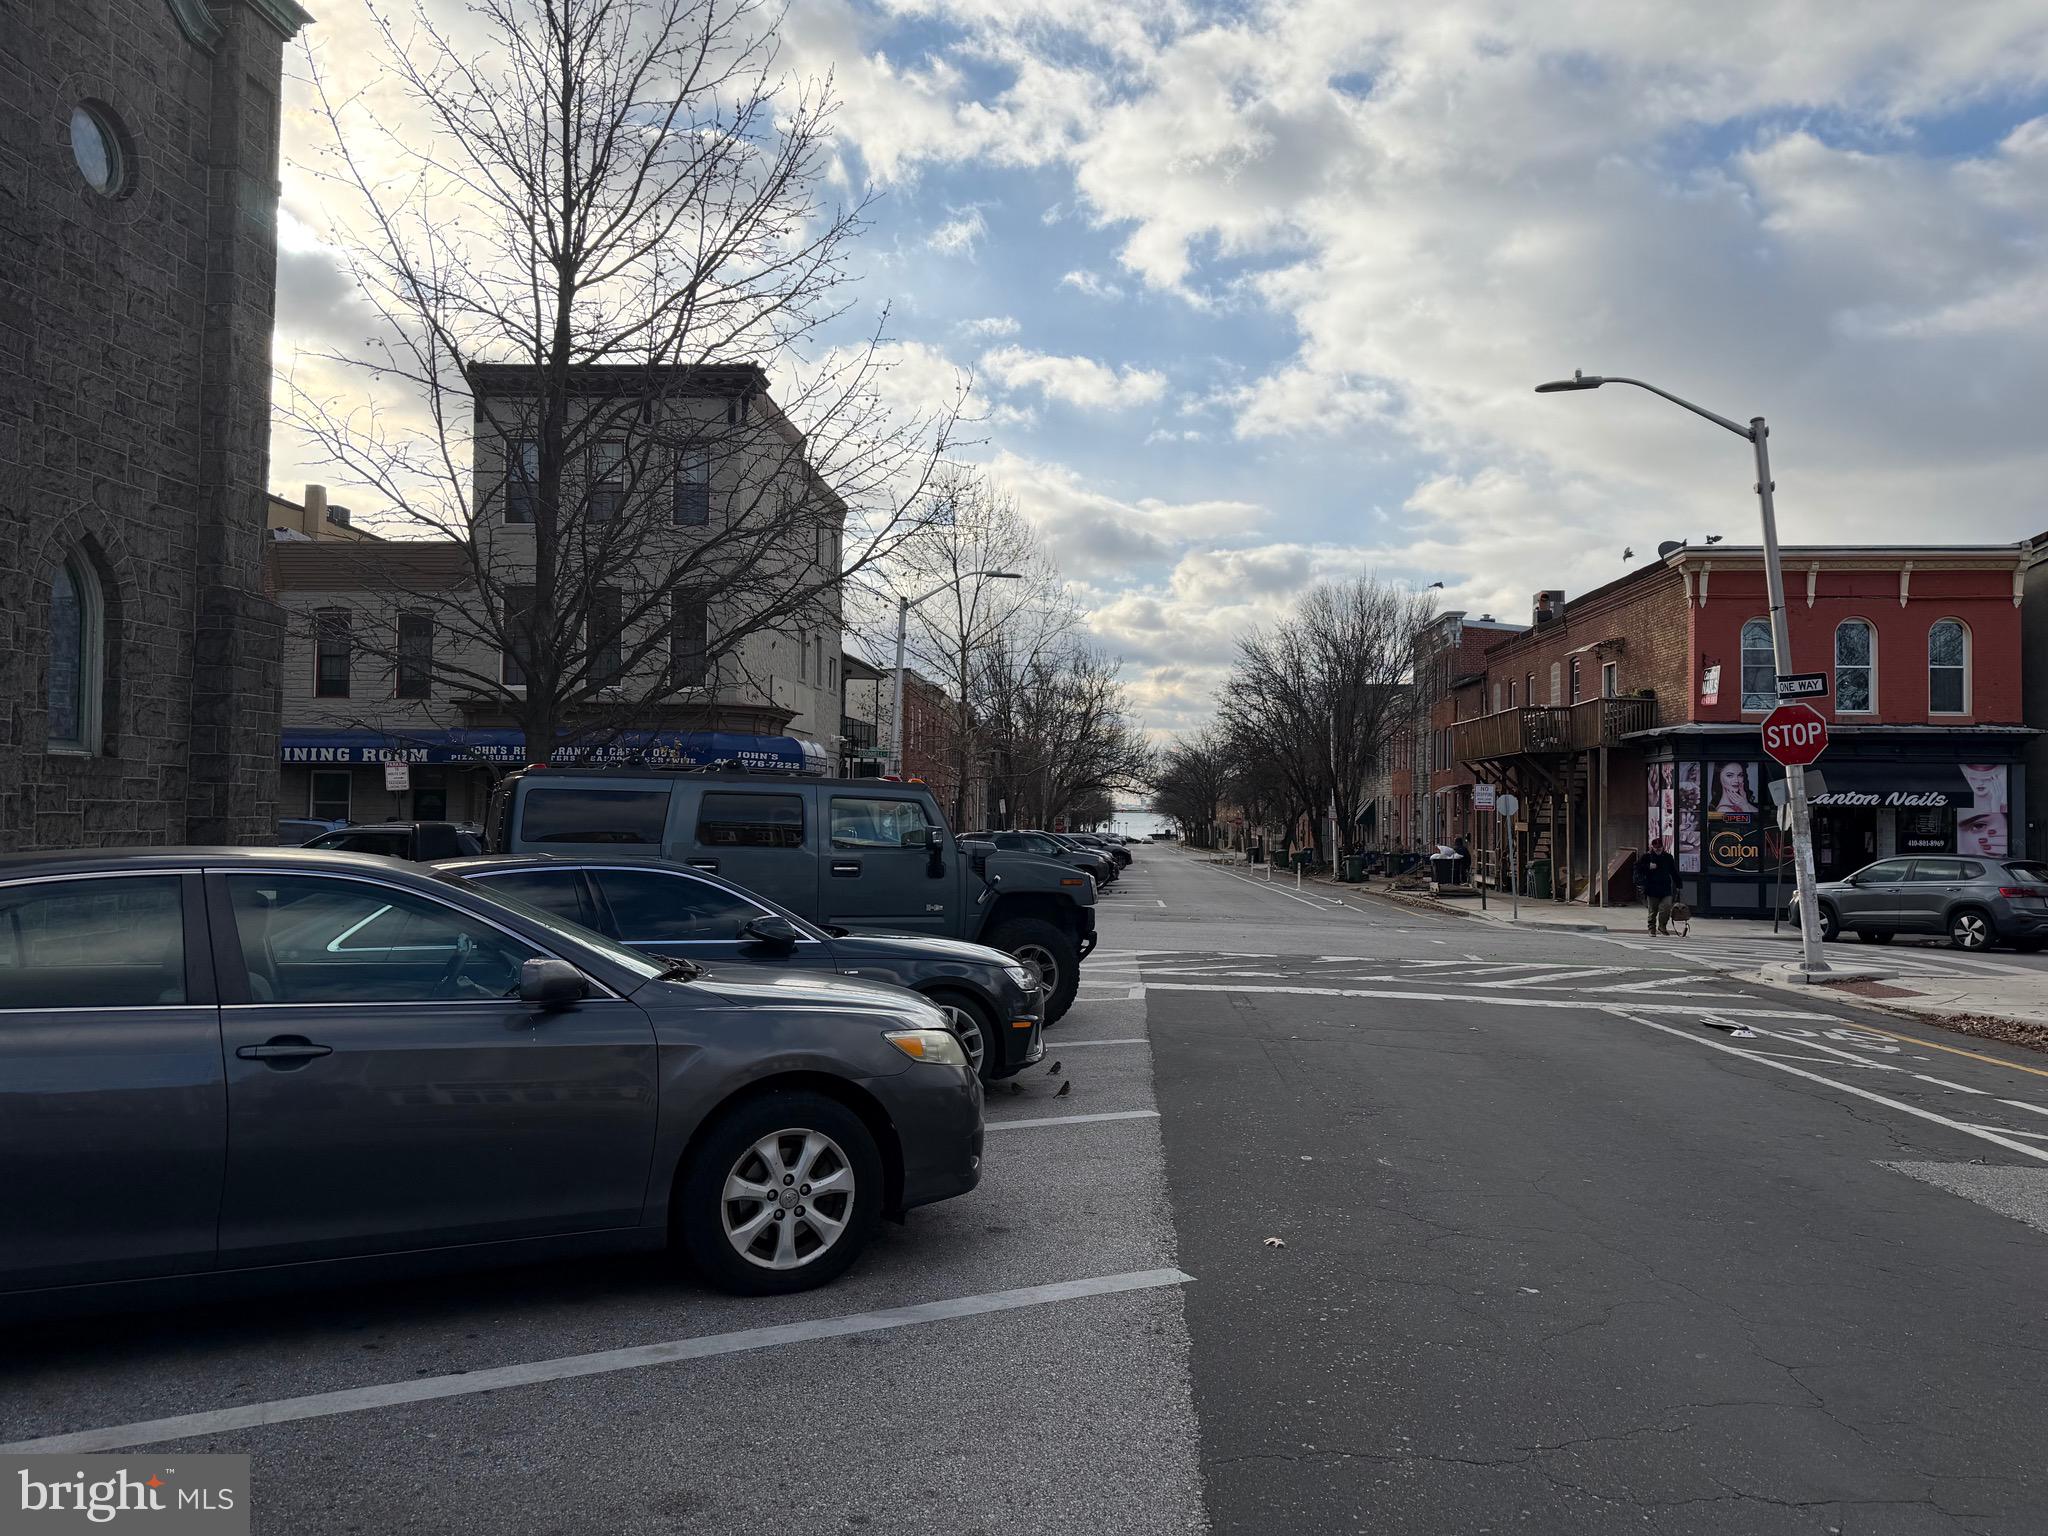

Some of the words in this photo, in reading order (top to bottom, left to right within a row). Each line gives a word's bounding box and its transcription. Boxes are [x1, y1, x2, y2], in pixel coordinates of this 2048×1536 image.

[1779, 682, 1795, 693] ONE
[1798, 680, 1819, 690] WAY
[1767, 722, 1821, 749] STOP
[283, 747, 350, 761] INING
[362, 748, 429, 762] ROOM
[738, 751, 779, 760] JOHN'S
[1884, 792, 1949, 807] Nails
[1709, 831, 1759, 868] Canton
